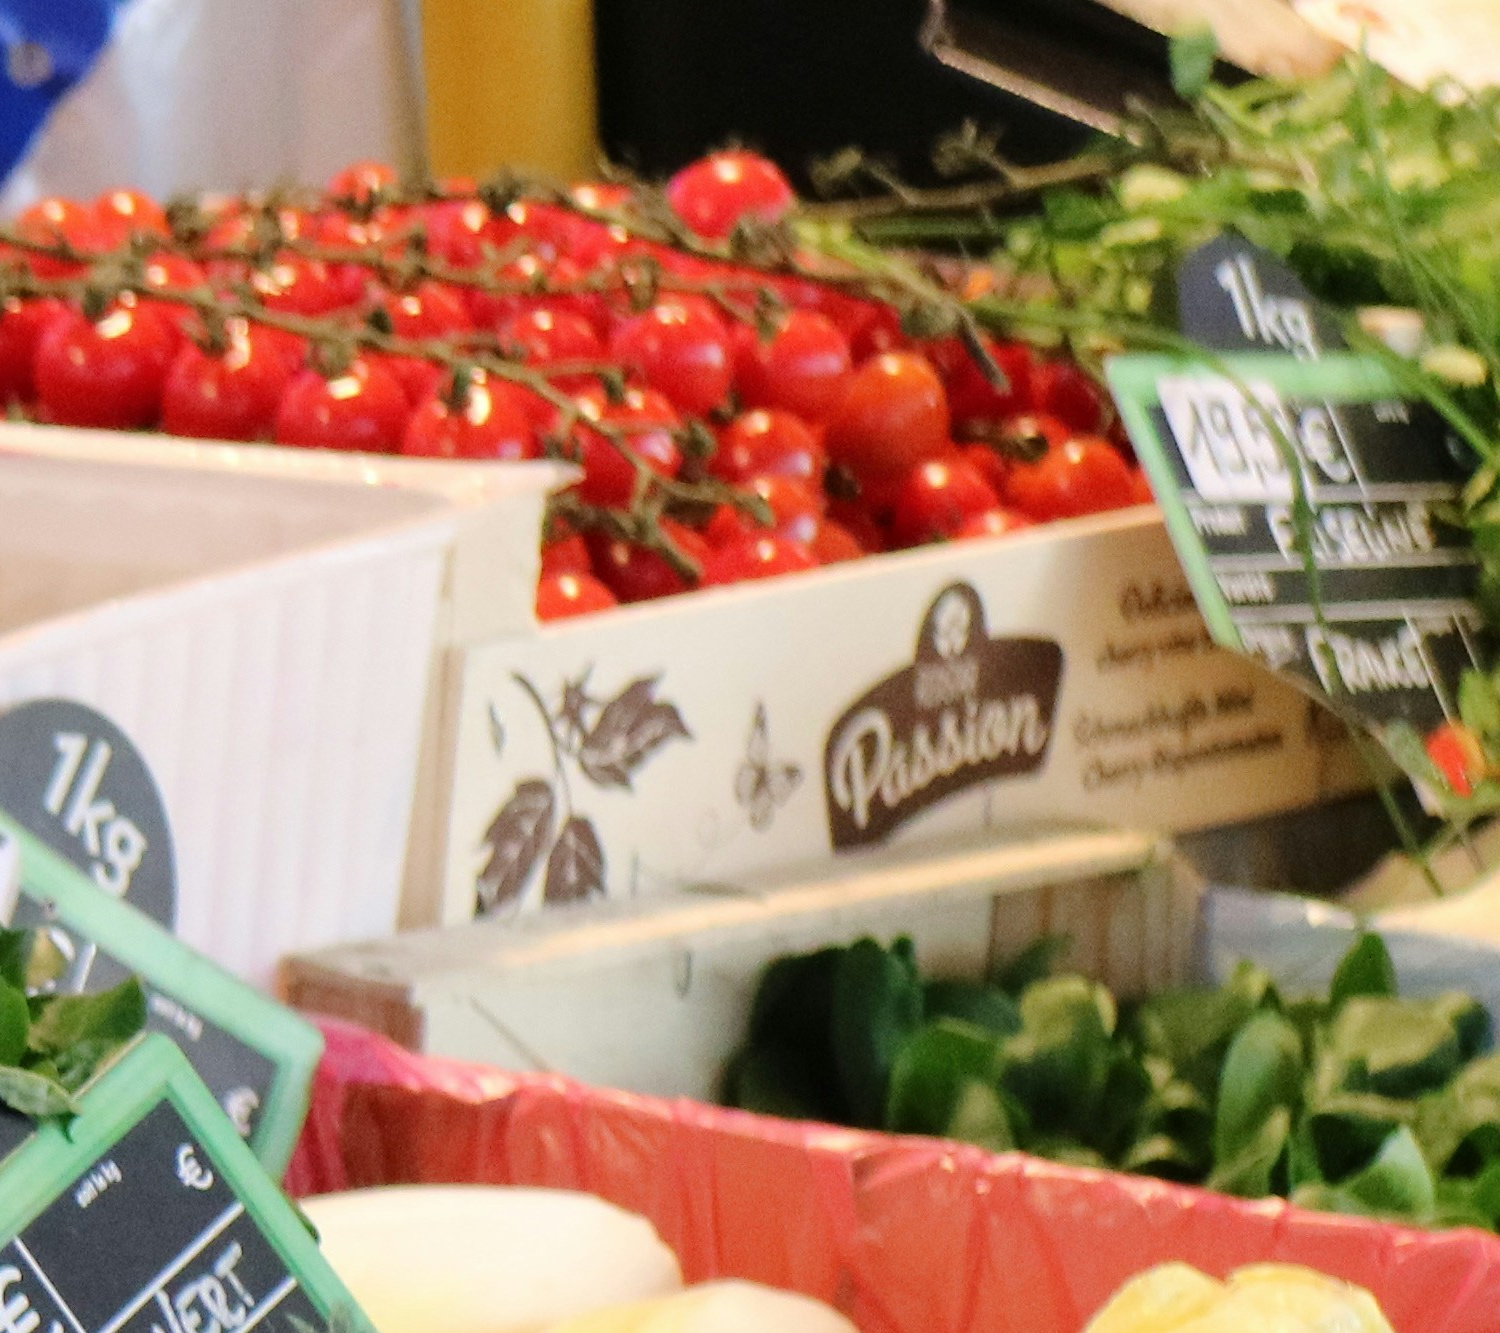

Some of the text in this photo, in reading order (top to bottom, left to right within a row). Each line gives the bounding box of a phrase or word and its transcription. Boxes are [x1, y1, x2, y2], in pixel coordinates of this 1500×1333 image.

[43, 730, 149, 900] 1kg
[830, 692, 1048, 831] Passion
[175, 1142, 214, 1191] €
